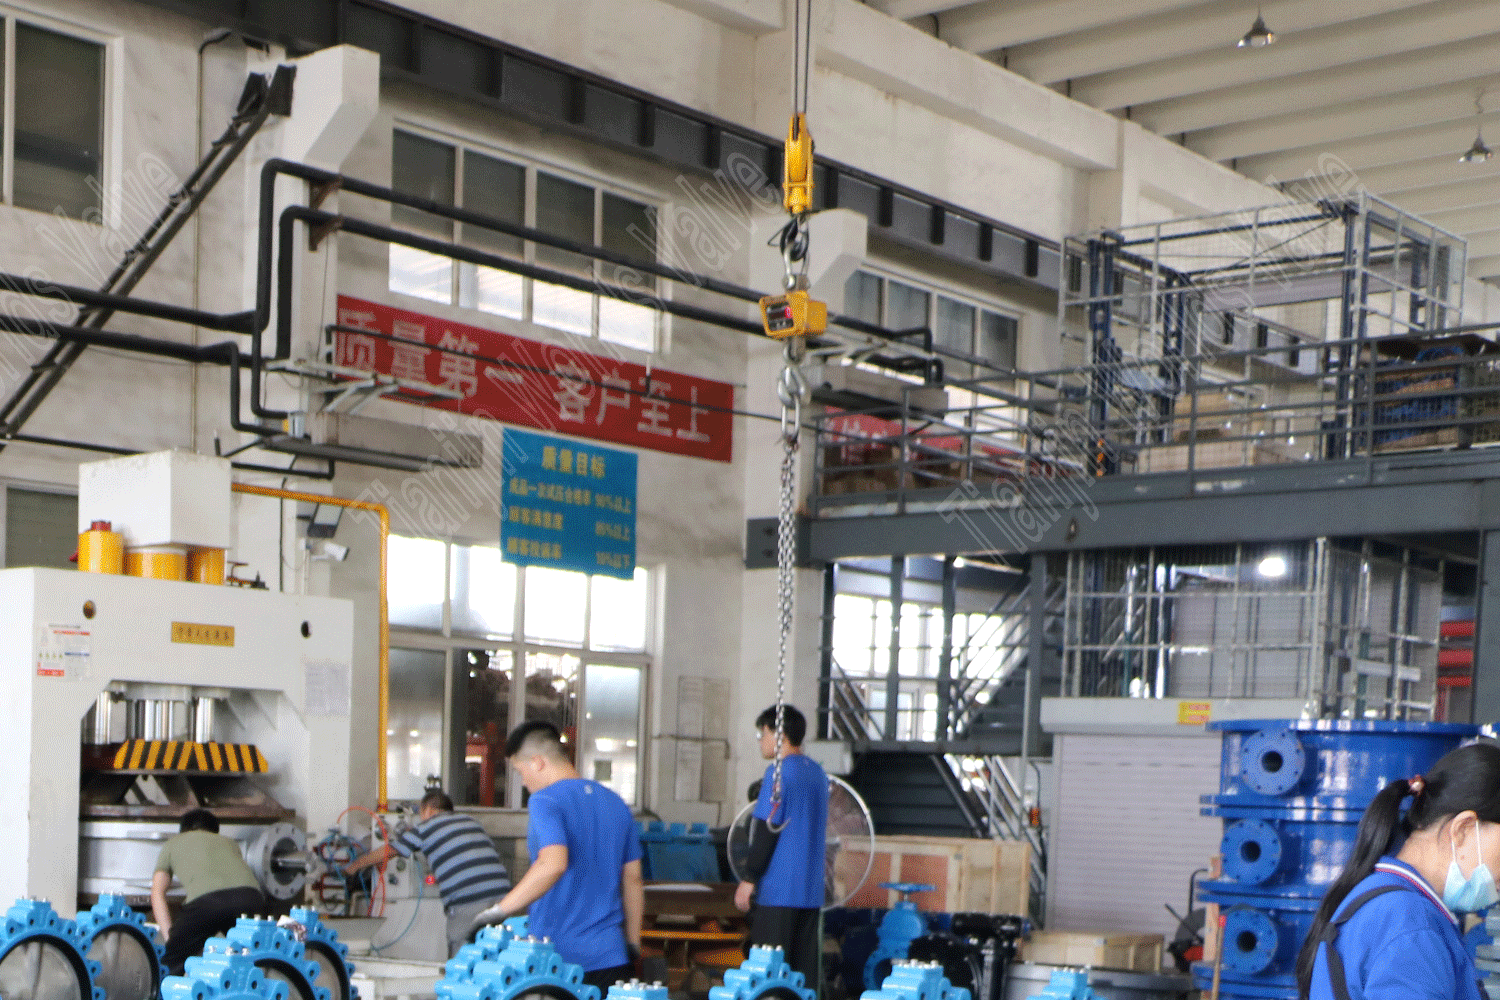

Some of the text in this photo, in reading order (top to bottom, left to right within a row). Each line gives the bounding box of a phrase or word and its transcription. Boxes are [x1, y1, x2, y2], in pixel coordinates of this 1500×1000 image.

[337, 308, 711, 443] 质量第一 客户至上
